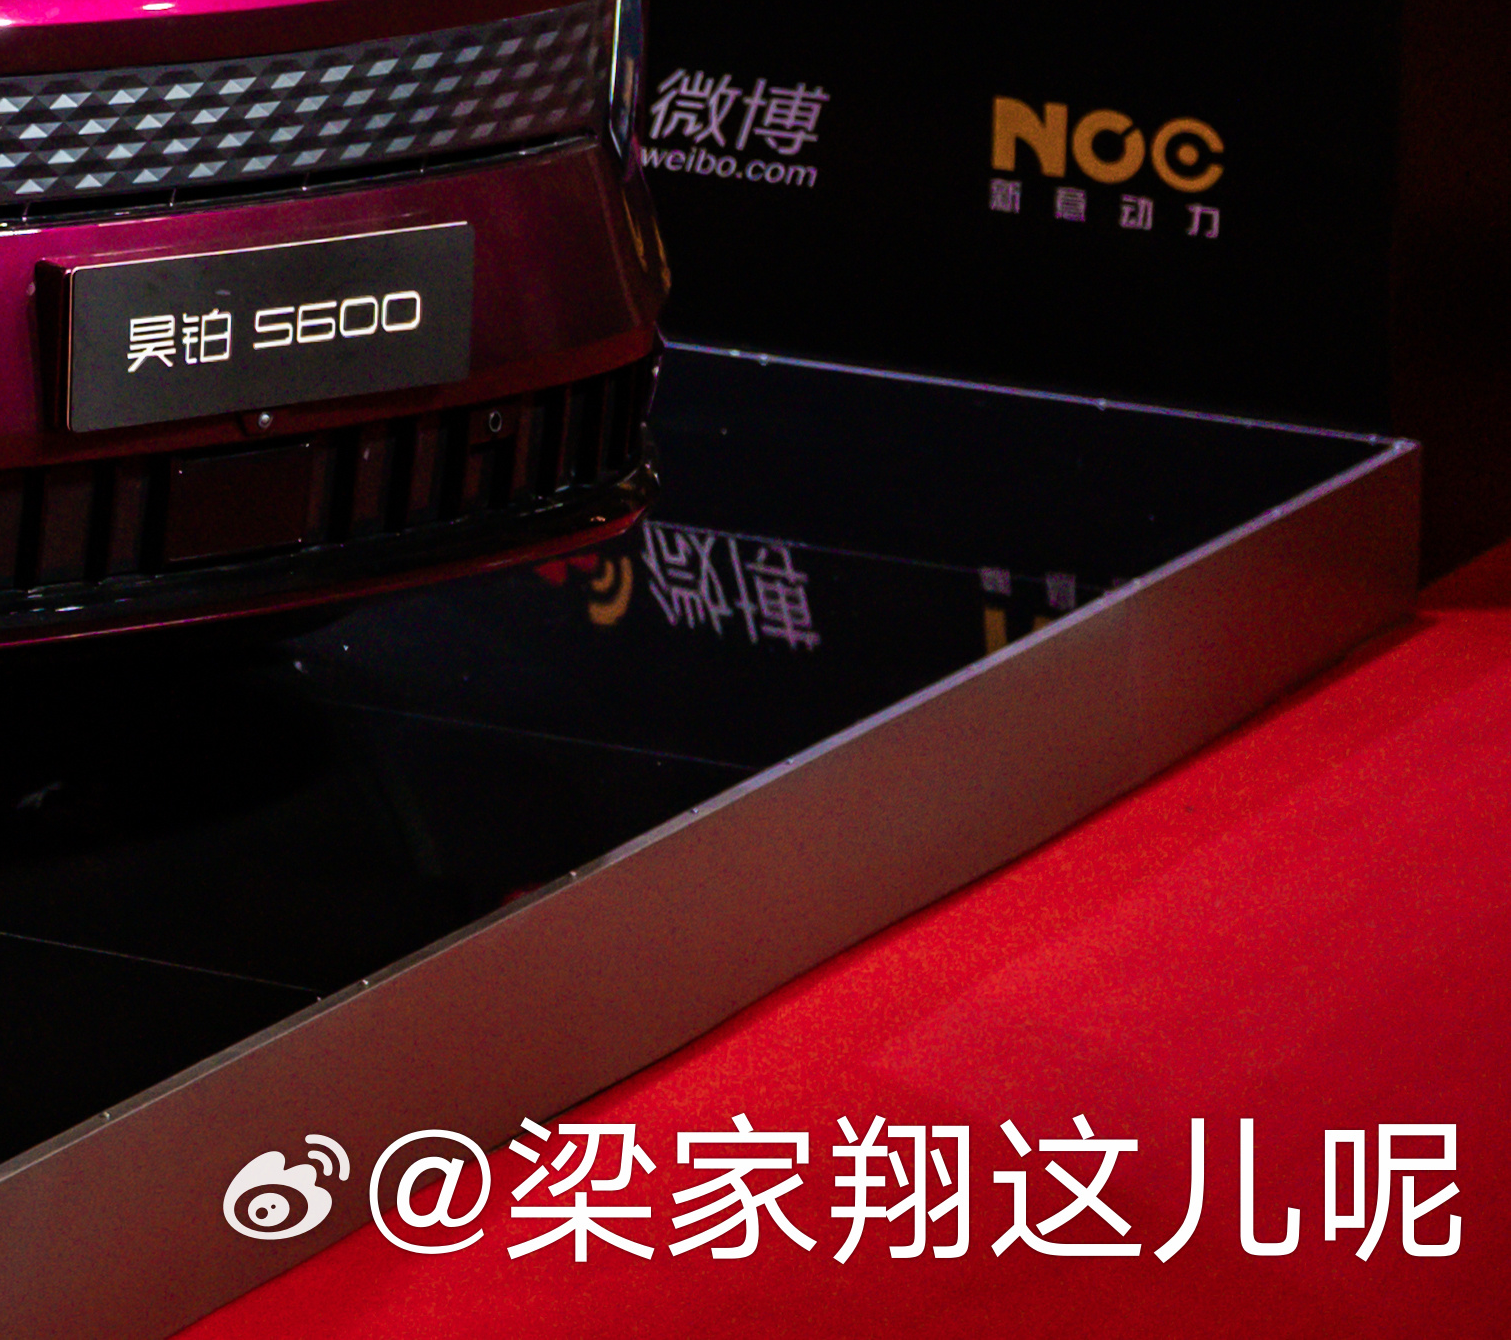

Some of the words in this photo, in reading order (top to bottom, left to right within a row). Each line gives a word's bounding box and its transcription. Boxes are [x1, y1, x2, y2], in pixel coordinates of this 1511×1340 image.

[649, 68, 829, 156] 微博
[991, 96, 1225, 193] NOC
[639, 146, 818, 188] weibo.com
[989, 178, 1221, 239] 新意动力
[127, 308, 233, 373] 昊铂
[253, 289, 422, 350] S600
